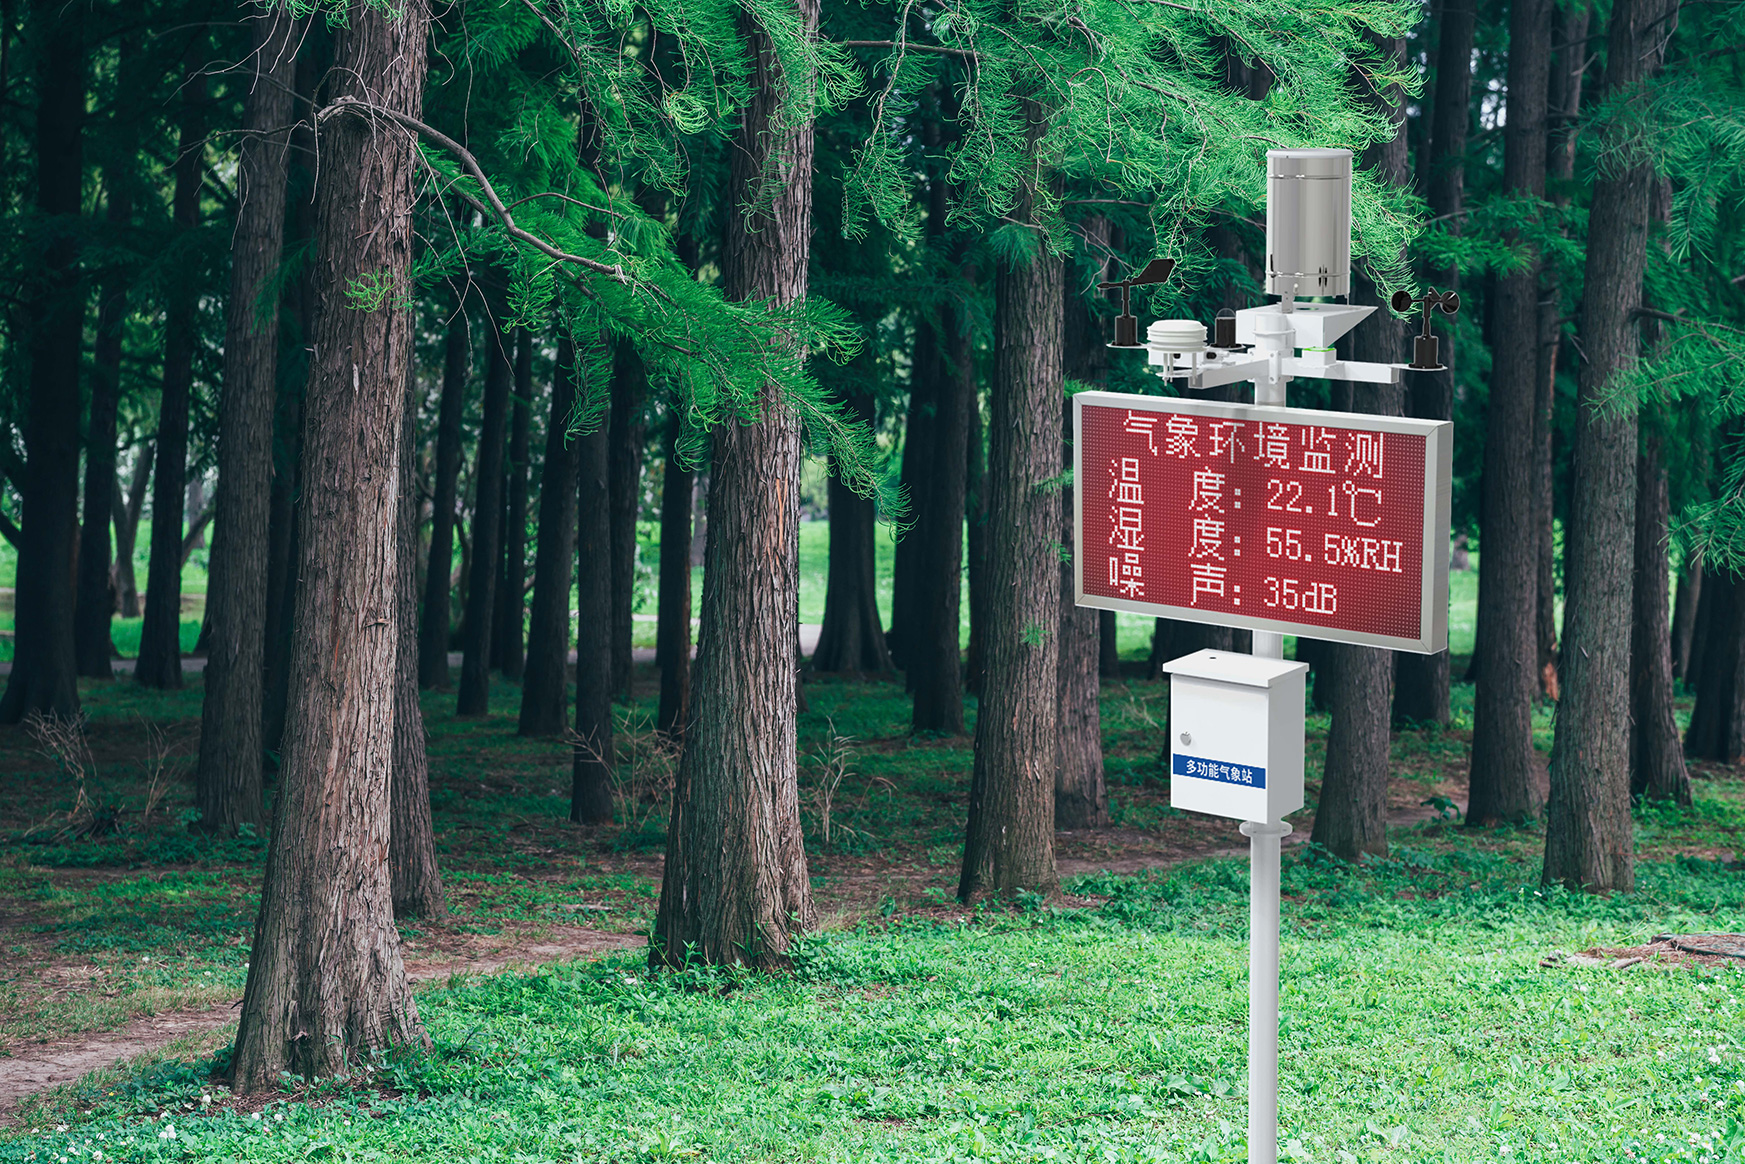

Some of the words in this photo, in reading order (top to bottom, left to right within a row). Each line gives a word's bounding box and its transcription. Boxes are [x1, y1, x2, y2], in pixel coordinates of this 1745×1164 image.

[1123, 410, 1384, 479] 气象环境监测
[1263, 576, 1338, 615] 35dB
[1186, 759, 1253, 784] 多功能气象站
